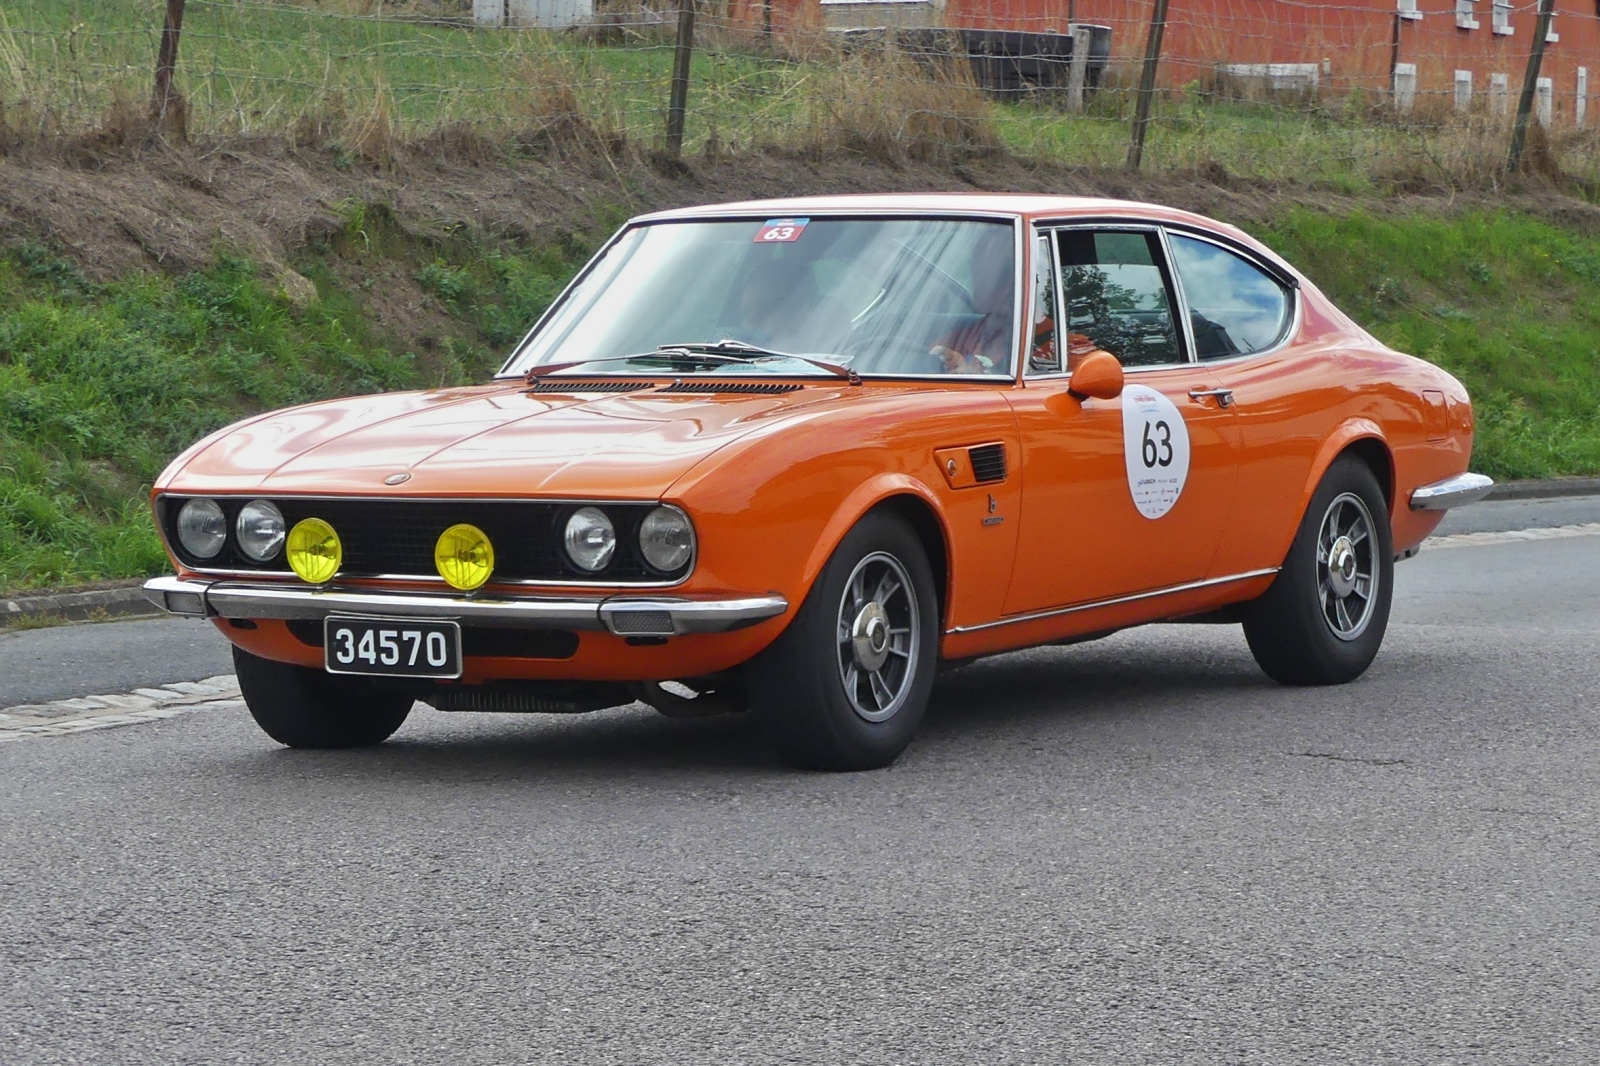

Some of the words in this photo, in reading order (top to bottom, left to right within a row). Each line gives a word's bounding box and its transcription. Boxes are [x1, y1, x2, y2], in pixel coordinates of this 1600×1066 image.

[763, 227, 795, 240] 63
[1142, 420, 1173, 468] 63
[335, 628, 447, 667] 34570
